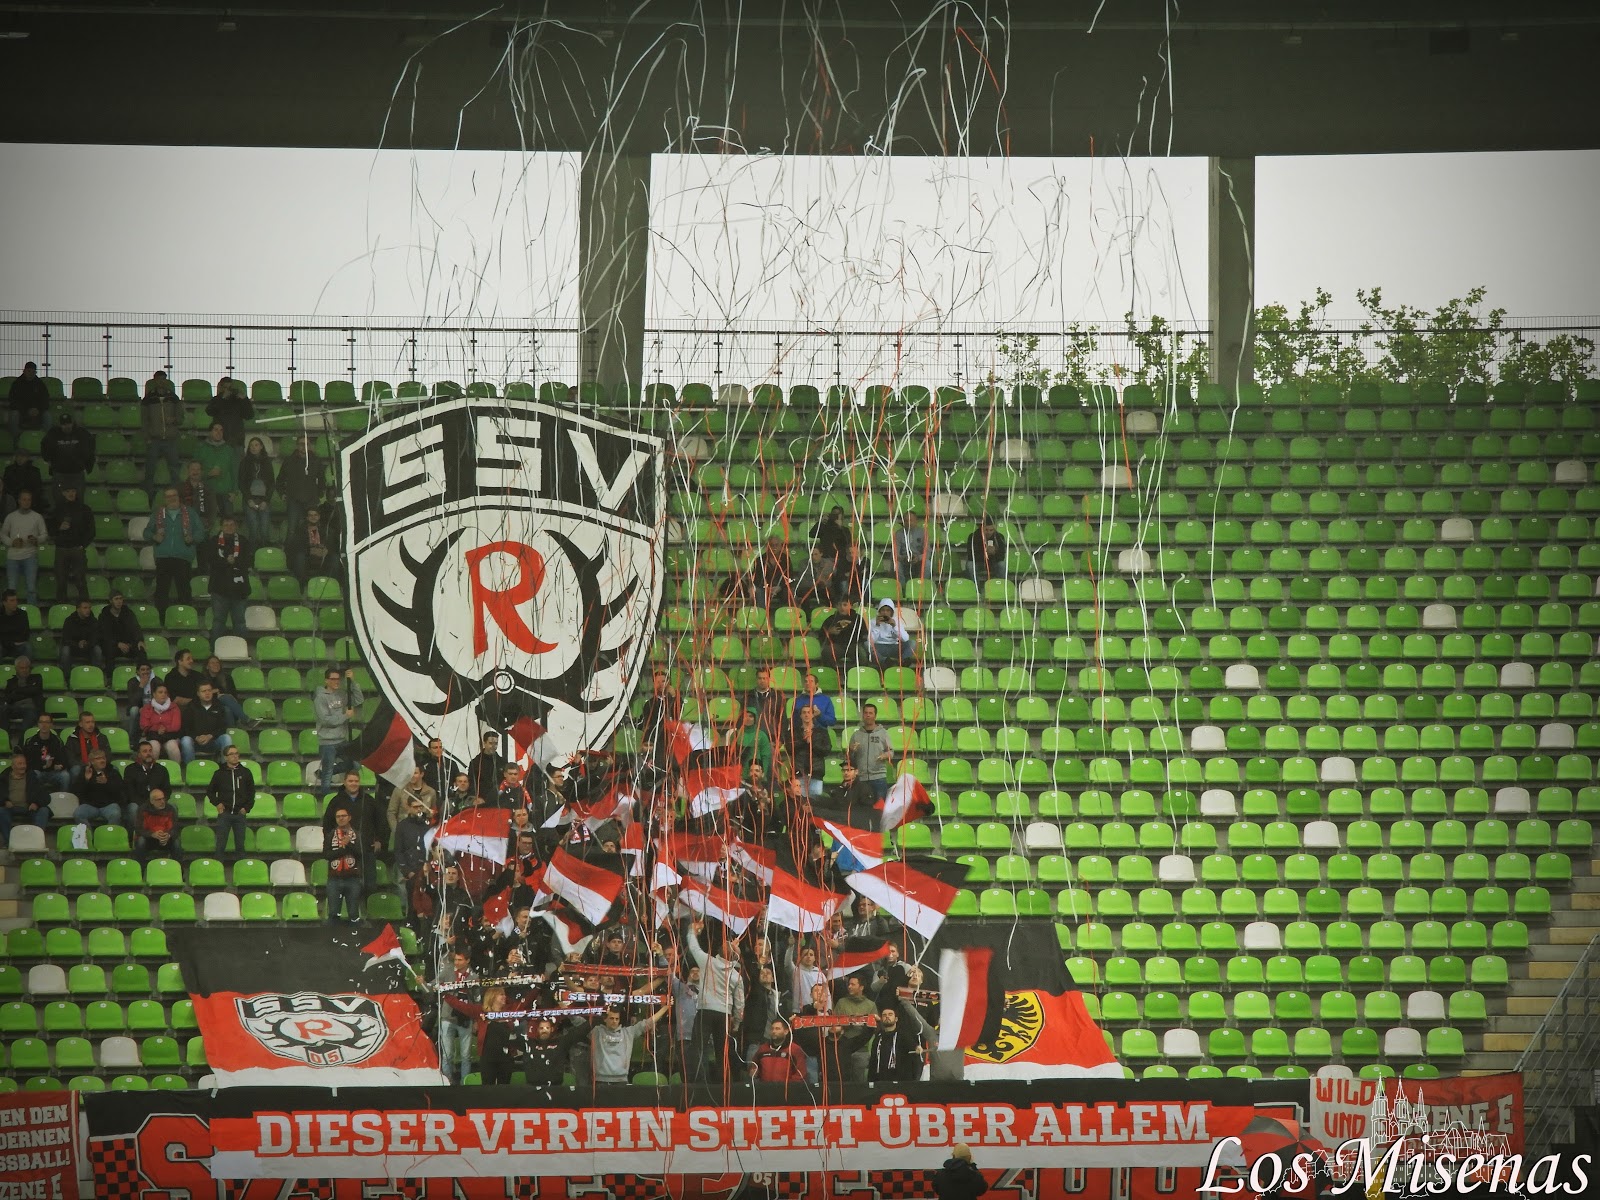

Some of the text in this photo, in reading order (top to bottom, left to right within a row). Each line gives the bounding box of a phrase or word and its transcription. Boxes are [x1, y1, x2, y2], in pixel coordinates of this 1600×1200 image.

[382, 415, 651, 515] SSV
[465, 540, 559, 659] R
[253, 995, 367, 1017] SSV
[568, 992, 661, 1005] SEIT 1905
[294, 1018, 342, 1040] R
[309, 1049, 340, 1064] 05
[1316, 1077, 1377, 1106] WILD
[30, 1104, 68, 1125] DEN
[256, 1096, 1210, 1154] DIESER VEREIN STEHT ÜBER ALLEM
[1324, 1112, 1366, 1138] UND
